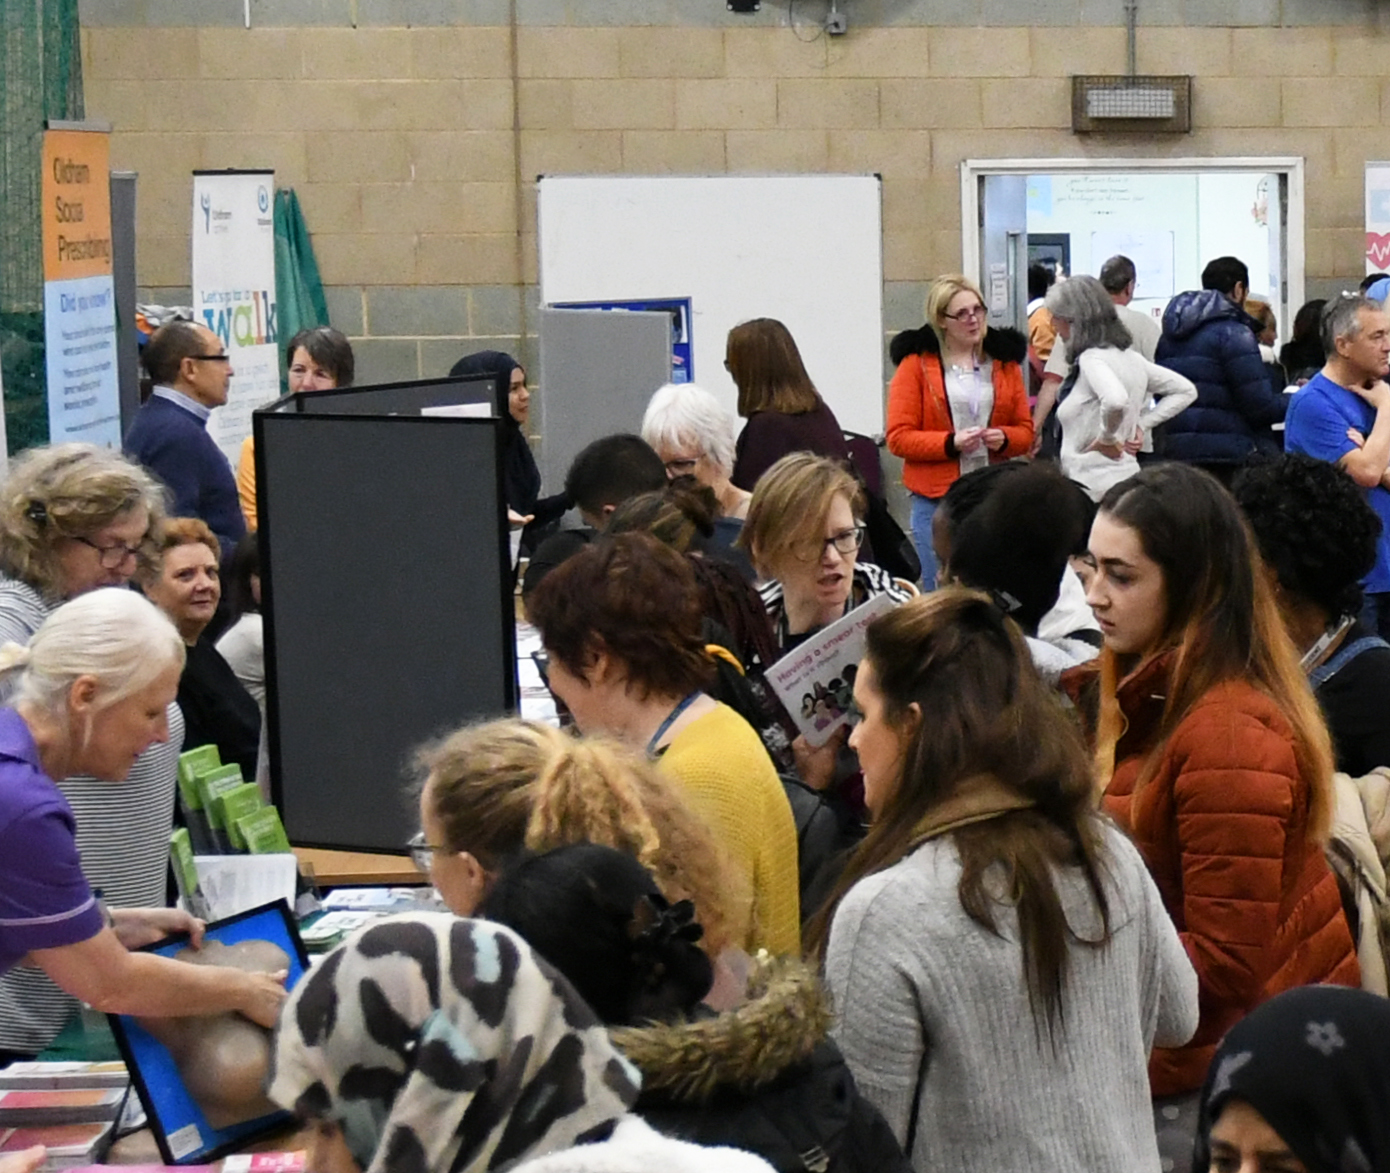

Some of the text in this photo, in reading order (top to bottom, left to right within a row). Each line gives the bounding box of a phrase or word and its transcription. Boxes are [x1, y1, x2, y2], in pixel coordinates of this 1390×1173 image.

[53, 157, 90, 184] Oldham
[58, 234, 111, 265] Prescribing
[202, 290, 278, 348] walk
[776, 654, 813, 684] Having
[813, 649, 821, 657] a
[822, 627, 854, 652] smear
